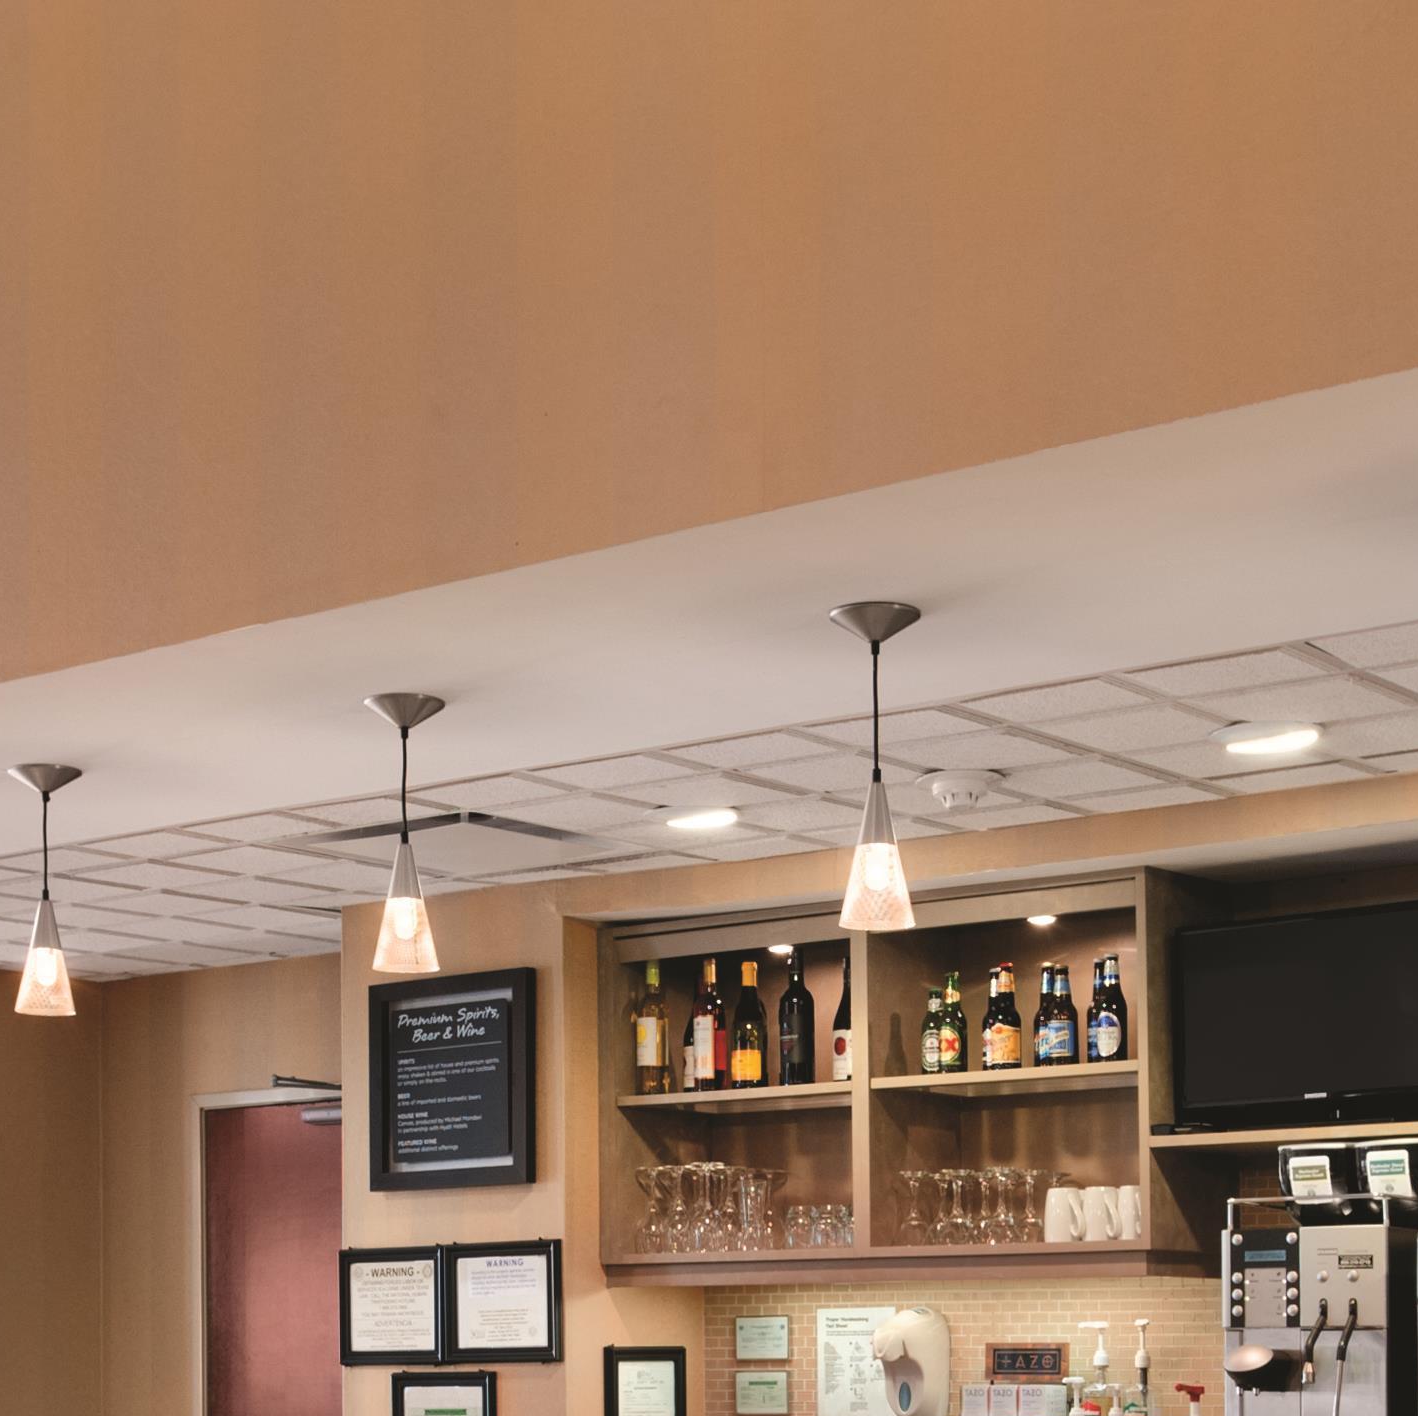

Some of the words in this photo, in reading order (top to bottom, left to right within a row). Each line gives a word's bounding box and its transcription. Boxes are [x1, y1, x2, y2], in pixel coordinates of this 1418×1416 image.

[397, 1011, 453, 1028] Premium
[456, 1006, 500, 1024] Spirits,
[412, 1028, 441, 1043] Beer
[442, 1026, 453, 1039] &
[456, 1022, 486, 1038] Wine
[485, 1258, 524, 1268] WARNING
[371, 1266, 414, 1277] WARNING
